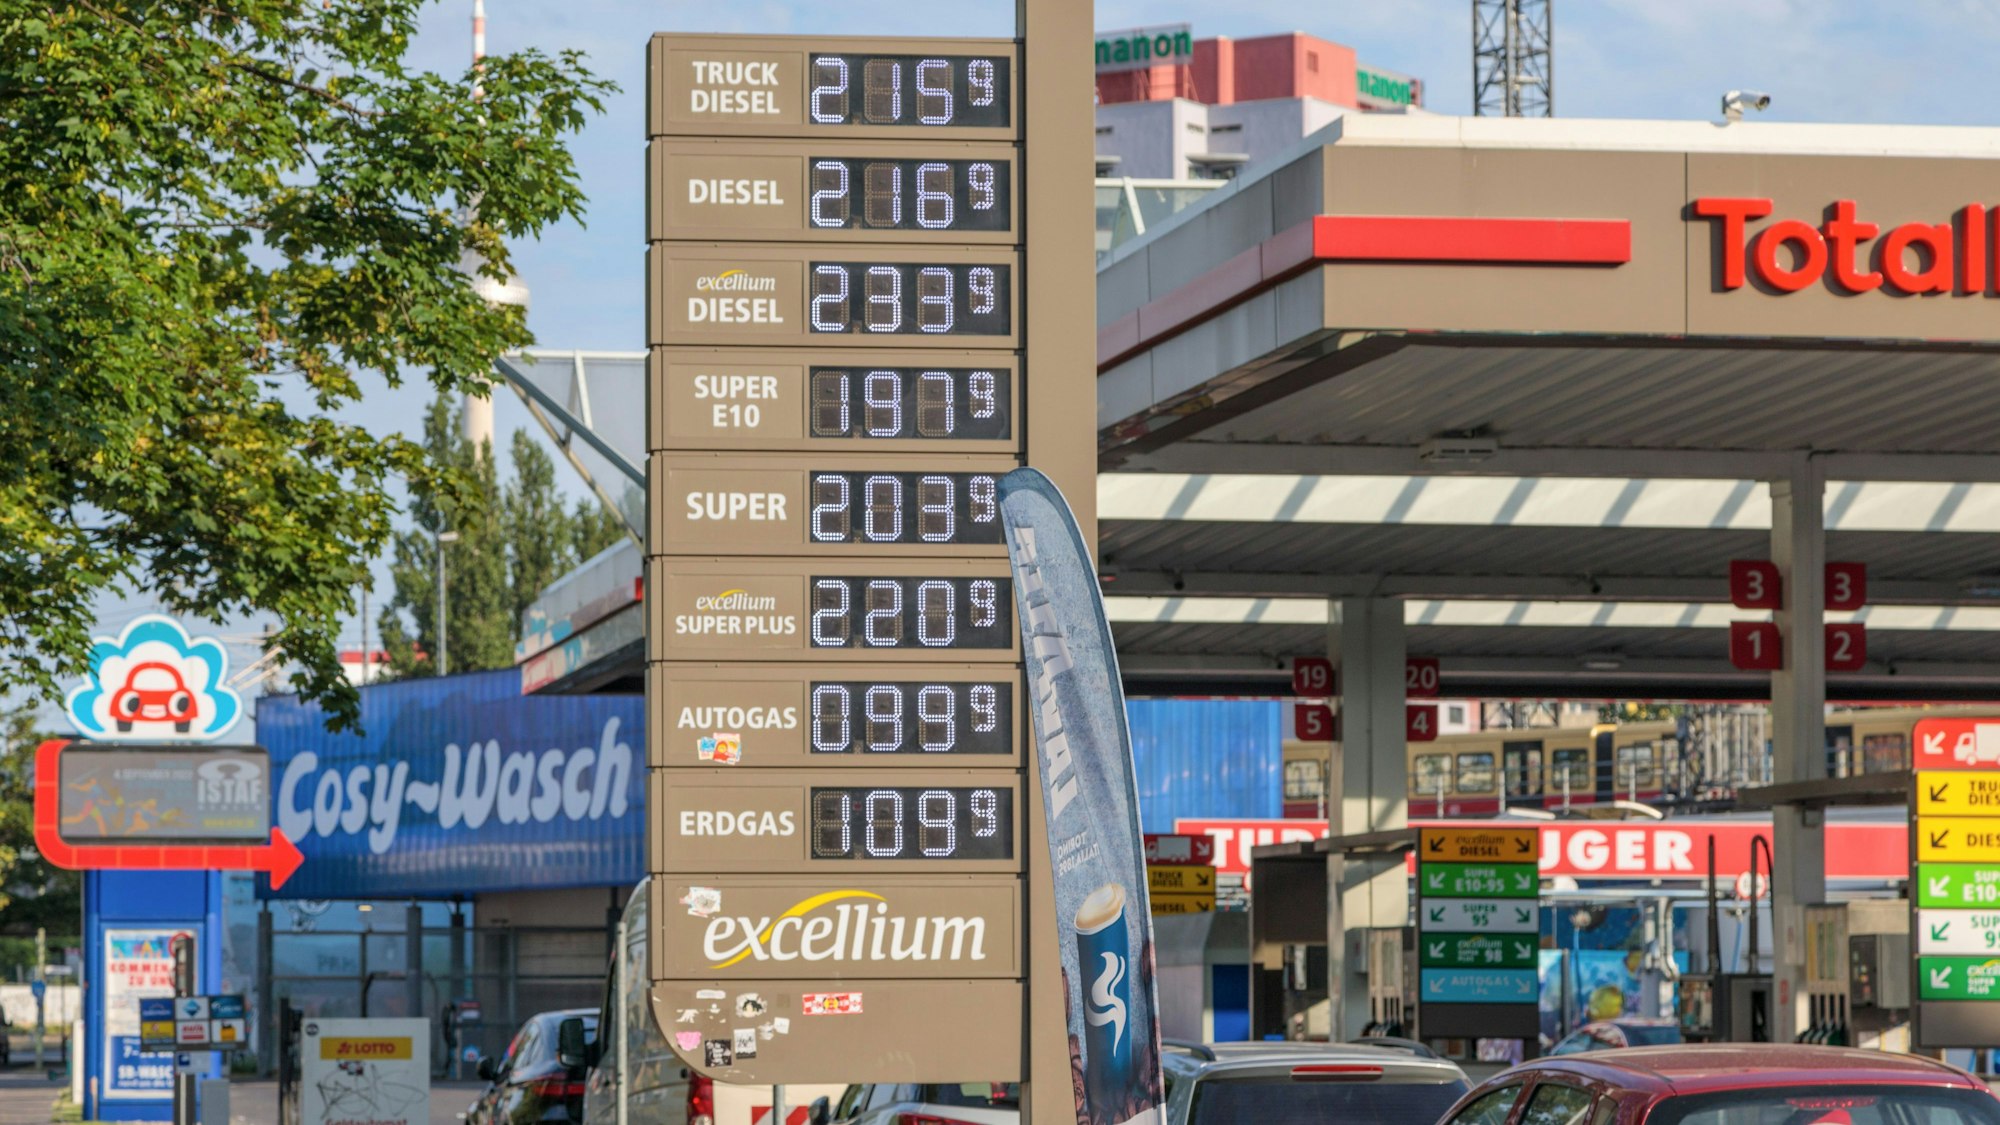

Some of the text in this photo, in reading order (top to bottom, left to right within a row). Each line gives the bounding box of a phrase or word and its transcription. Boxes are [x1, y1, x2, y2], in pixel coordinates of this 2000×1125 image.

[692, 61, 778, 85] TRUCK
[690, 90, 780, 114] DIESEL
[688, 179, 784, 205] DIESEL
[1695, 197, 2000, 293] Total
[696, 270, 776, 291] excellium
[688, 298, 783, 323] DIESEL
[694, 375, 778, 399] SUPER
[712, 404, 760, 428] E10
[686, 492, 787, 520] SUPER
[1746, 570, 1764, 600] 3
[1833, 572, 1852, 602] 3
[696, 591, 776, 612] excellium
[675, 615, 796, 635] SUPER PLUS
[1747, 630, 1762, 660] 1
[1833, 631, 1853, 662] 2
[1300, 665, 1328, 689] 19
[1406, 665, 1437, 689] 20
[677, 706, 797, 729] AUTOGAS
[1306, 711, 1322, 735] 5
[1412, 711, 1428, 734] 4
[197, 780, 262, 804] ISTAF
[1969, 780, 2000, 792] TRU
[680, 811, 795, 836] ERDGAS
[1459, 846, 1501, 857] DIESEL
[1464, 868, 1497, 878] SUPER
[1454, 879, 1505, 893] E10-95
[1463, 903, 1498, 913] SUPER
[703, 901, 987, 962] excellium
[1472, 914, 1489, 927] 95
[1484, 949, 1503, 963] 98
[1451, 975, 1510, 987] AUTOGAS
[354, 1042, 396, 1054] LOTTO
